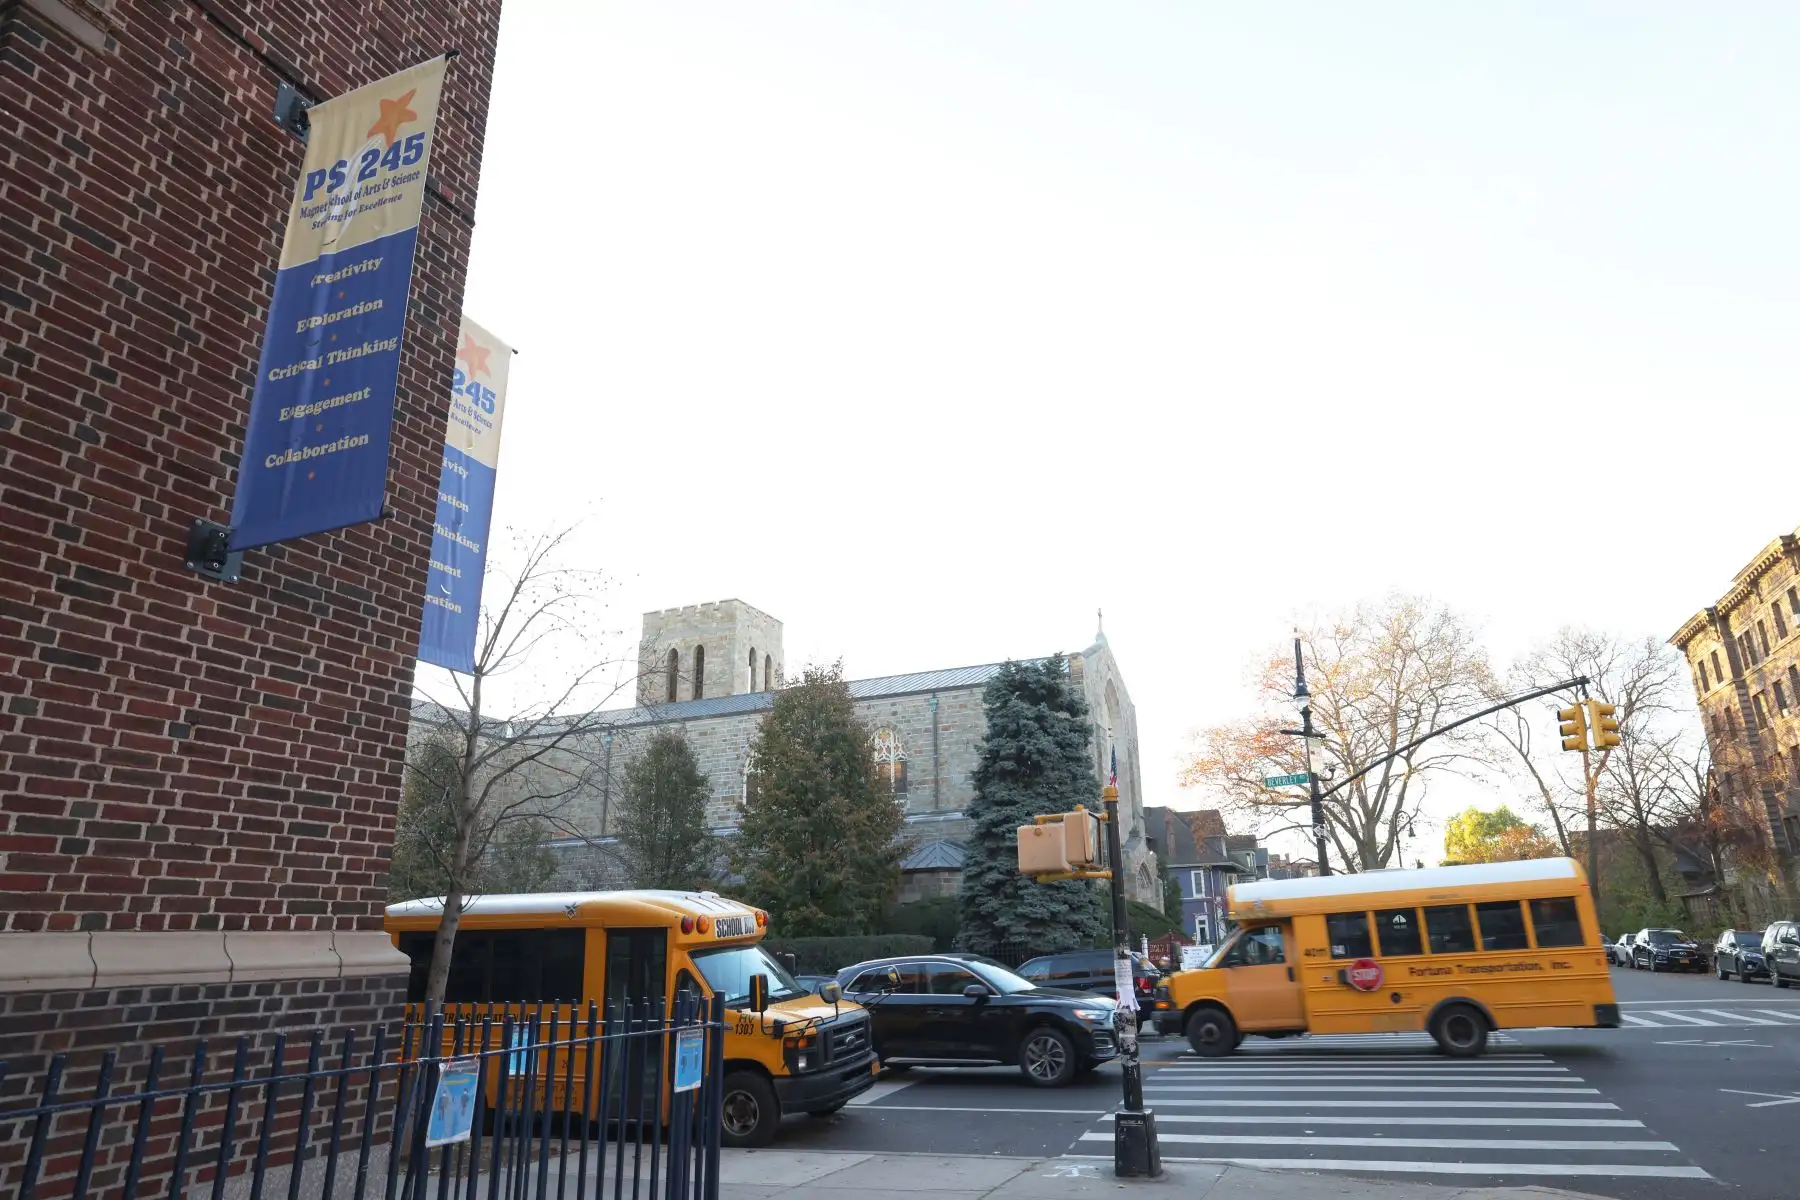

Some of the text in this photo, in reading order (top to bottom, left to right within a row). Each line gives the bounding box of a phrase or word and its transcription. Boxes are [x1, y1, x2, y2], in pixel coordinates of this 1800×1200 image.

[303, 132, 425, 201] PS 245
[328, 192, 353, 208] chool
[362, 183, 381, 198] Arts
[382, 178, 390, 190] &
[391, 171, 420, 187] Science
[312, 194, 403, 230] String for Excellence
[296, 299, 383, 334] Eploration
[327, 336, 398, 365] Thinking
[279, 386, 371, 421] Egagement
[453, 368, 496, 414] 245
[453, 399, 466, 414] Arts
[473, 411, 493, 429] Science
[265, 434, 369, 468] Collaboration
[1267, 775, 1297, 786] BEVERLEY
[716, 915, 755, 938] SCHOOL BUS
[1353, 968, 1379, 981] STOP
[1408, 967, 1453, 977] Fortuna
[735, 1023, 755, 1035] 1303
